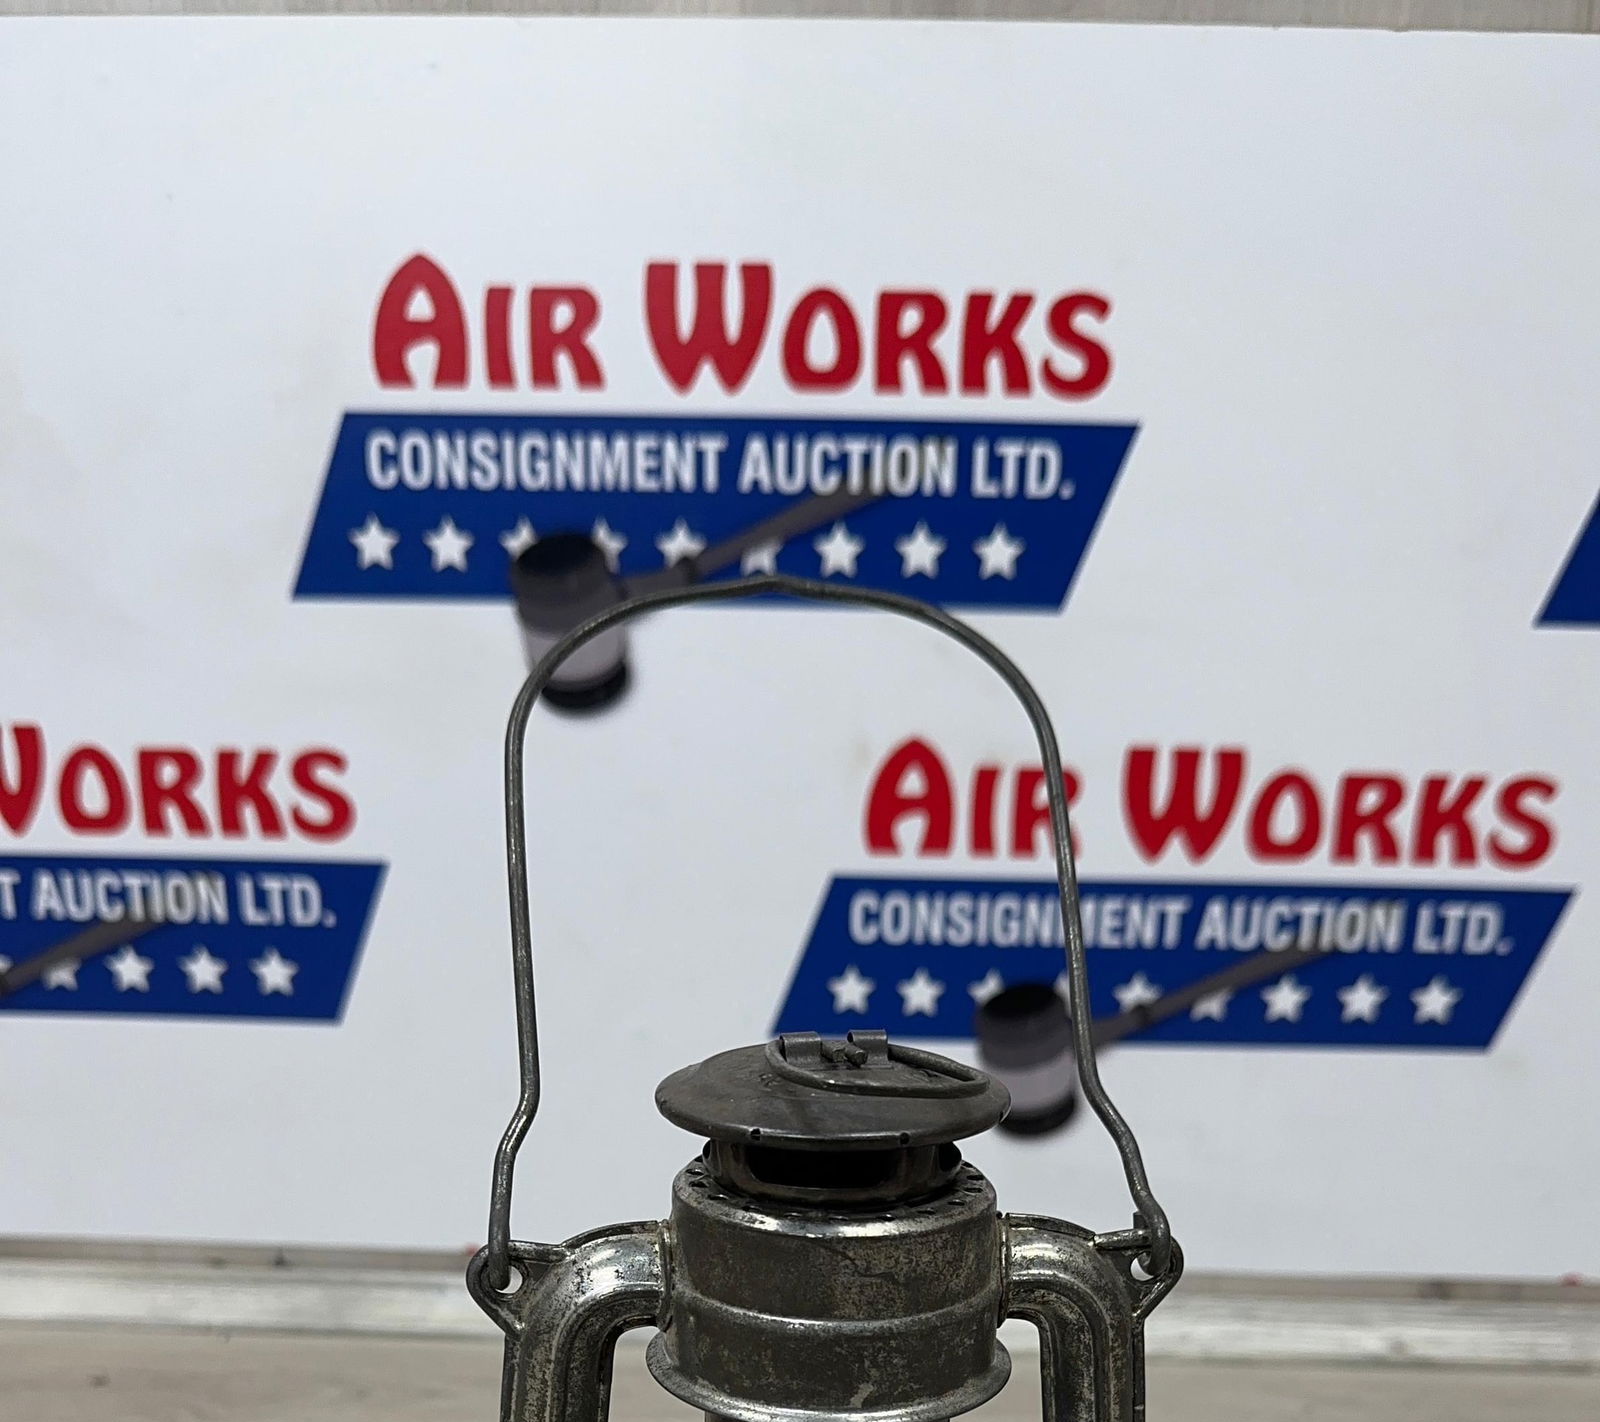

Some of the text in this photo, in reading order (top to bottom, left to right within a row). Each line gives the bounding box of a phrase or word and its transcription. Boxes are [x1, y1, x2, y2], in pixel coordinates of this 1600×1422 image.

[371, 253, 1113, 399] AIR WORKS
[365, 430, 1076, 500] CONSIGNMENT AUCTION LTD.
[862, 737, 1556, 869] AIR WORKS
[31, 868, 229, 924] AUCTION
[237, 873, 337, 928] LTD.
[1194, 896, 1408, 954] AUCTION
[1413, 901, 1514, 956] LTD.
